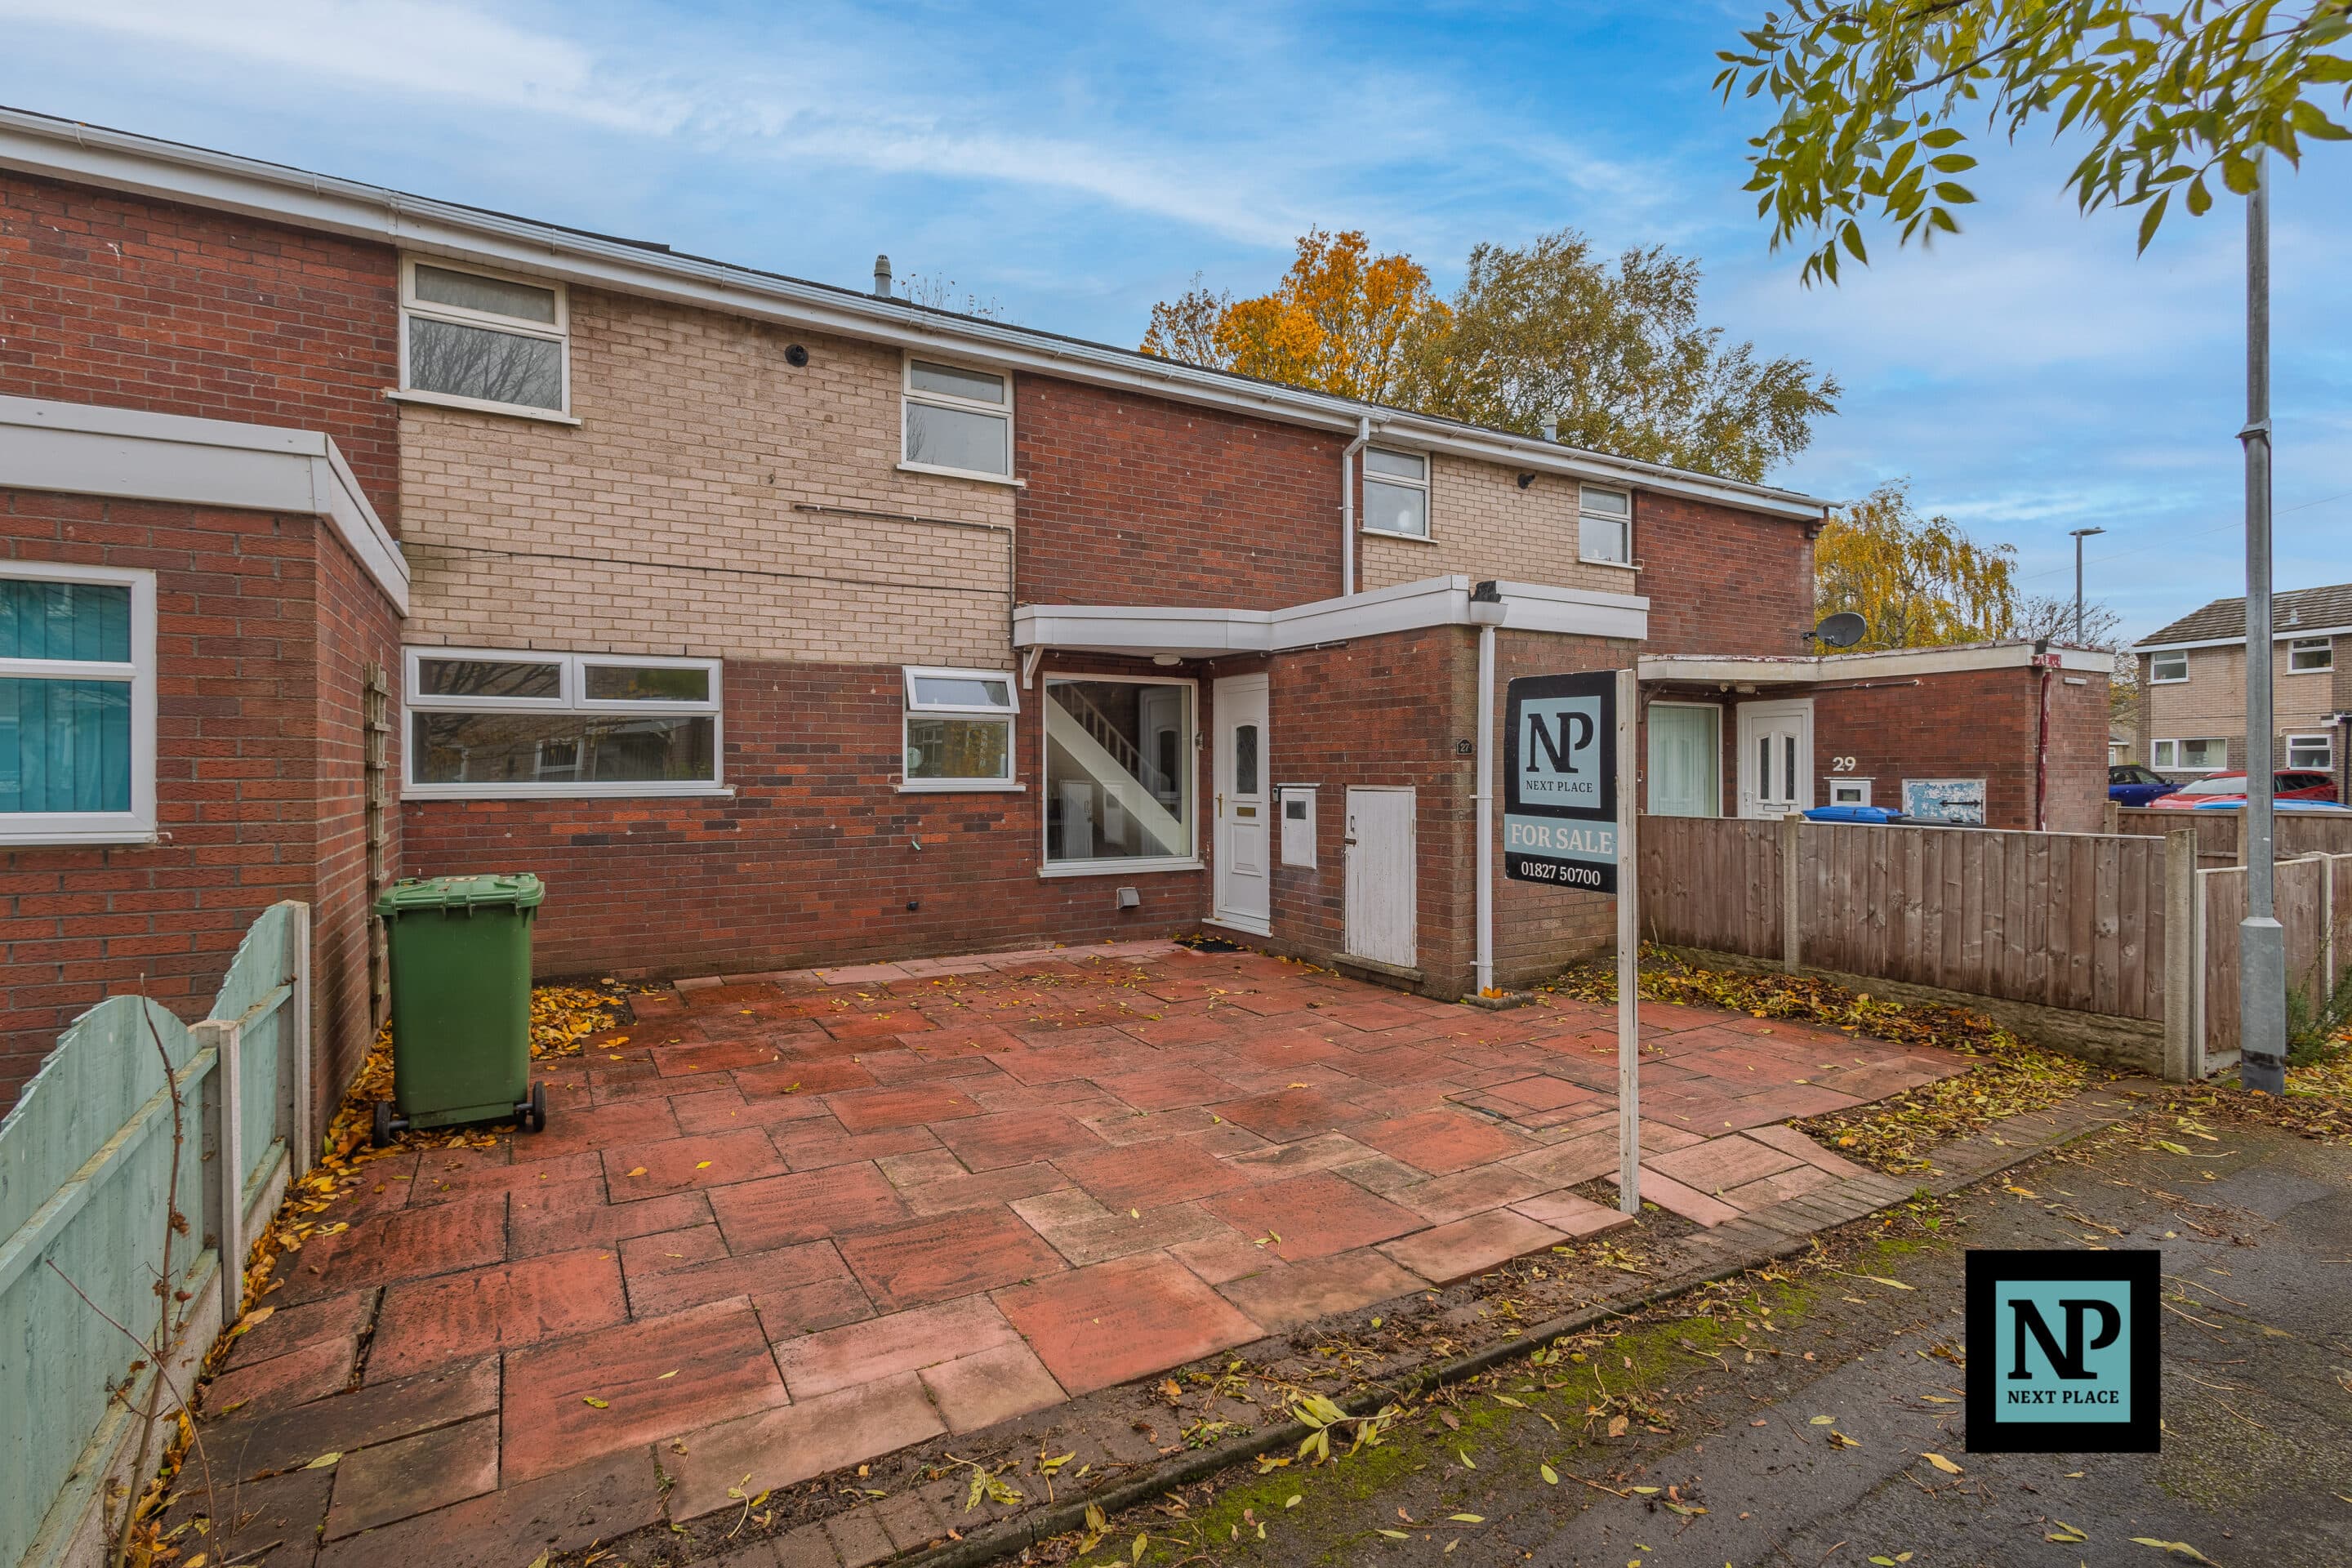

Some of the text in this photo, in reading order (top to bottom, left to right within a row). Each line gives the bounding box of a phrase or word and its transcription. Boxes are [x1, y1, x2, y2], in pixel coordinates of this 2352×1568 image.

[1460, 743, 1470, 751] 27
[1526, 711, 1593, 773] NP
[1833, 756, 1856, 772] 29
[1526, 780, 1593, 793] NEXT PLACE
[1511, 823, 1613, 855] FOR SALE
[1521, 861, 1601, 886] 01827 50700
